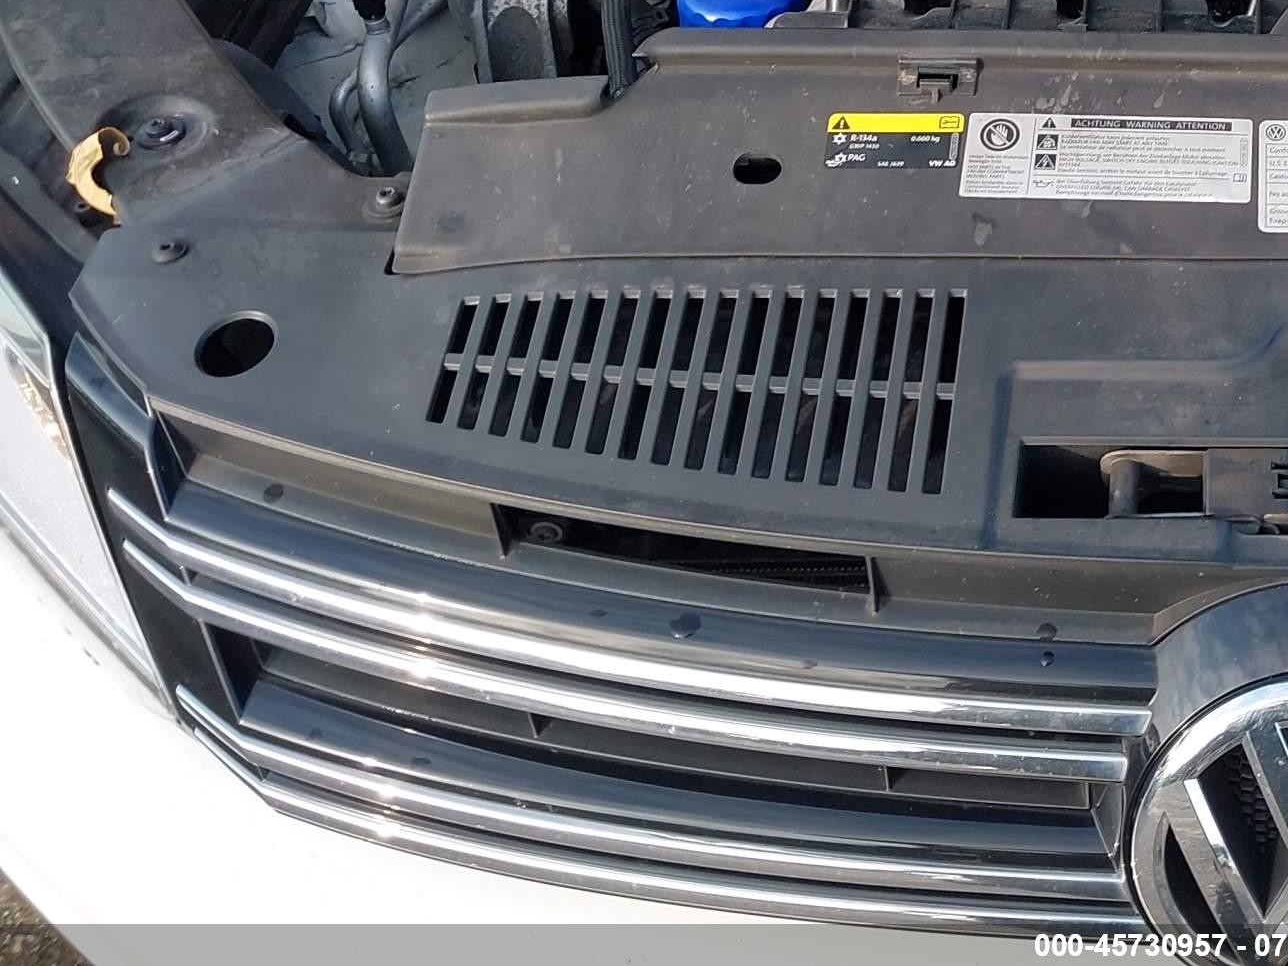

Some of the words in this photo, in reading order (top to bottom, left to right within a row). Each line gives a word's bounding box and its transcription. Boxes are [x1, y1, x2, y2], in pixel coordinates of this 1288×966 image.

[1075, 120, 1120, 128] ACHTUNG
[1176, 122, 1226, 130] ATTENTION
[850, 134, 878, 142] R-134a
[931, 135, 941, 143] kg
[847, 153, 866, 162] PAG
